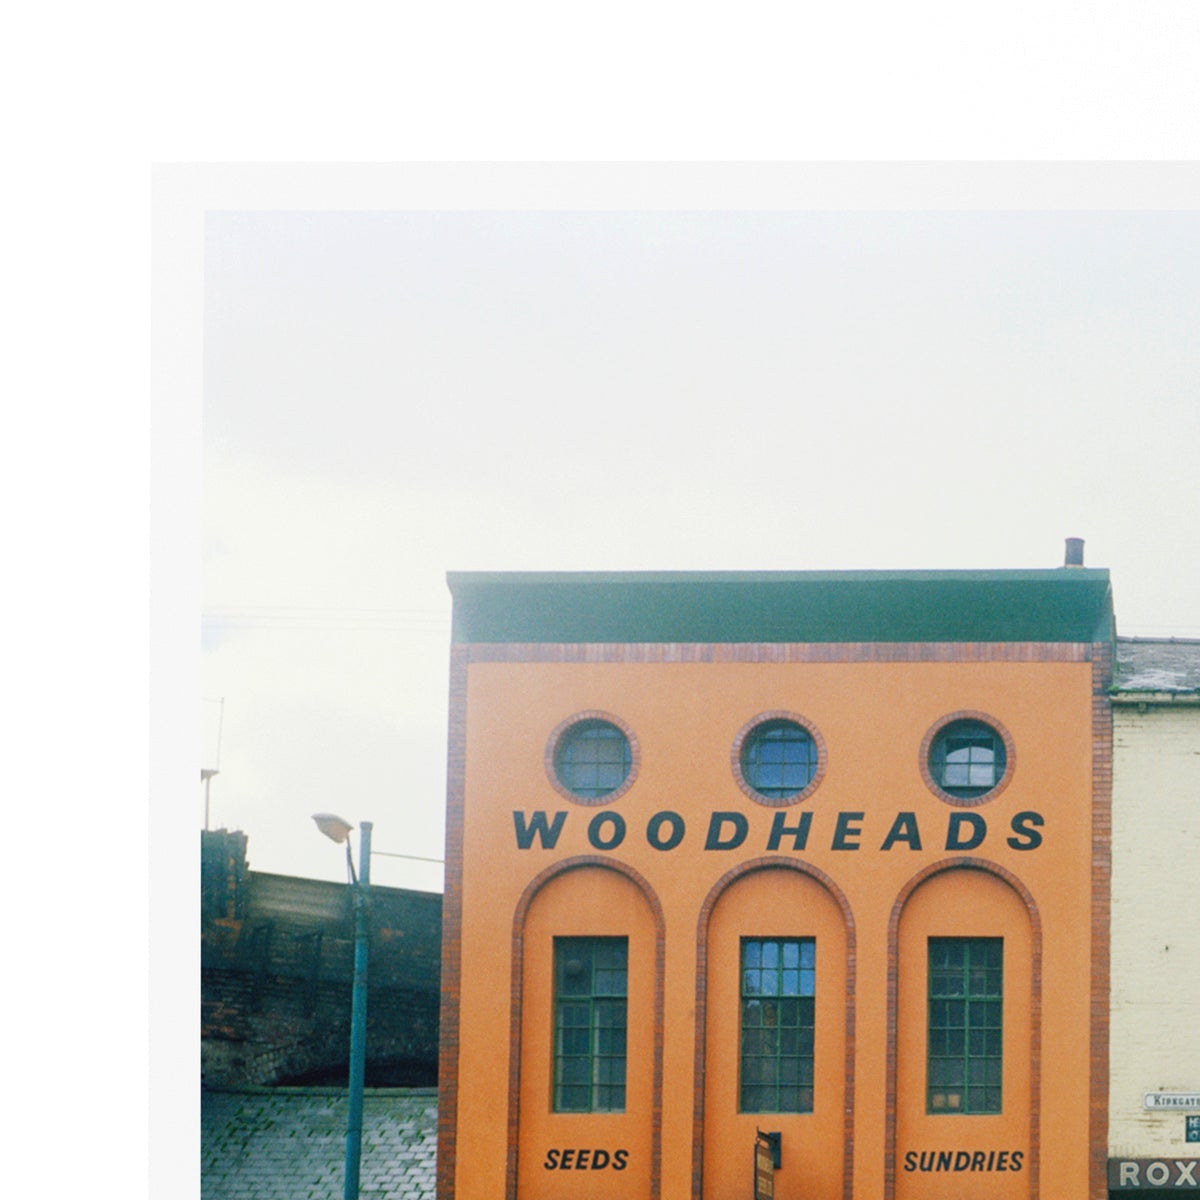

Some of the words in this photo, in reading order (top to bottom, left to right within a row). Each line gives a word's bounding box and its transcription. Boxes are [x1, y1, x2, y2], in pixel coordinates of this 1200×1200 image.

[512, 811, 1044, 852] WOODHEADS
[544, 1149, 629, 1170] SEEDS
[904, 1151, 1024, 1172] SUNDRIES
